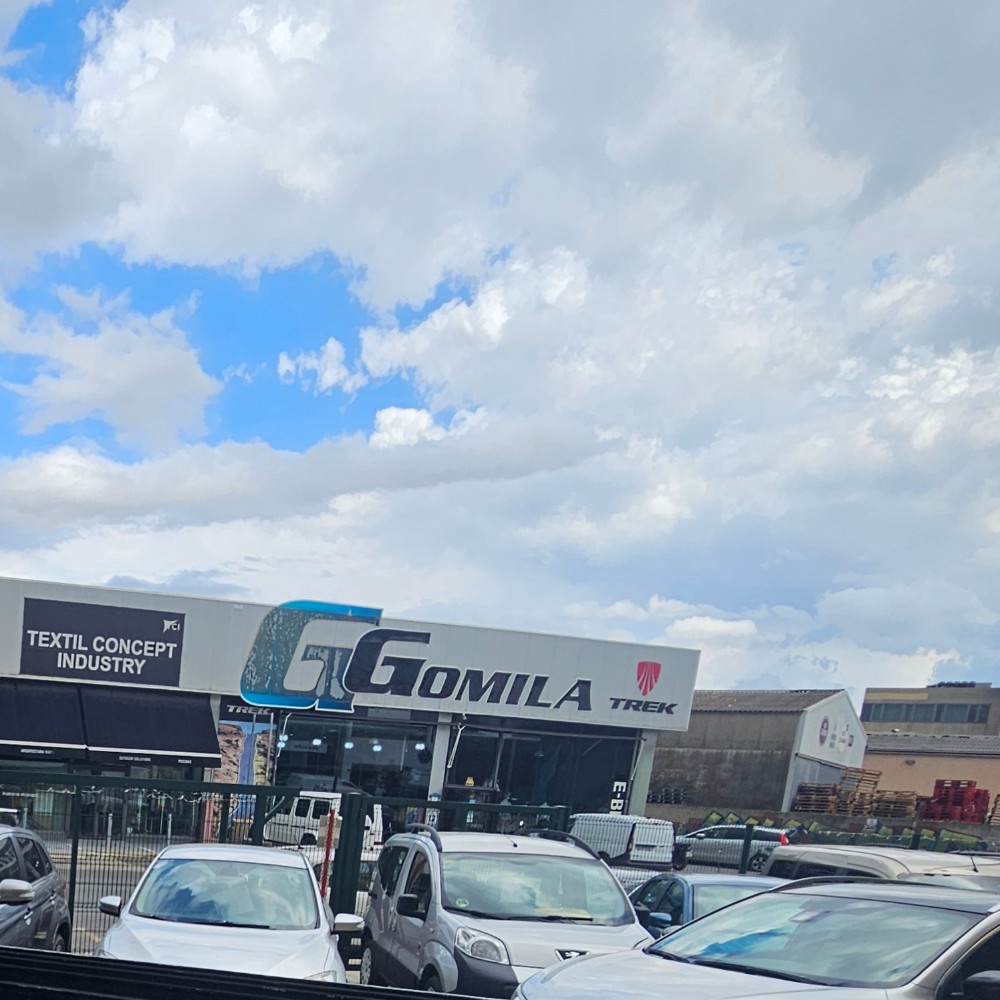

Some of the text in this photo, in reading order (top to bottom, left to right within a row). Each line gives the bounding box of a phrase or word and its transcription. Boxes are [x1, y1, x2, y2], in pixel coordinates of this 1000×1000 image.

[27, 630, 177, 658] TEXTIL CONCEPT
[57, 652, 146, 675] INDUSTRY
[344, 628, 593, 711] GOMILA
[227, 704, 271, 715] TREK
[609, 697, 678, 715] TREK
